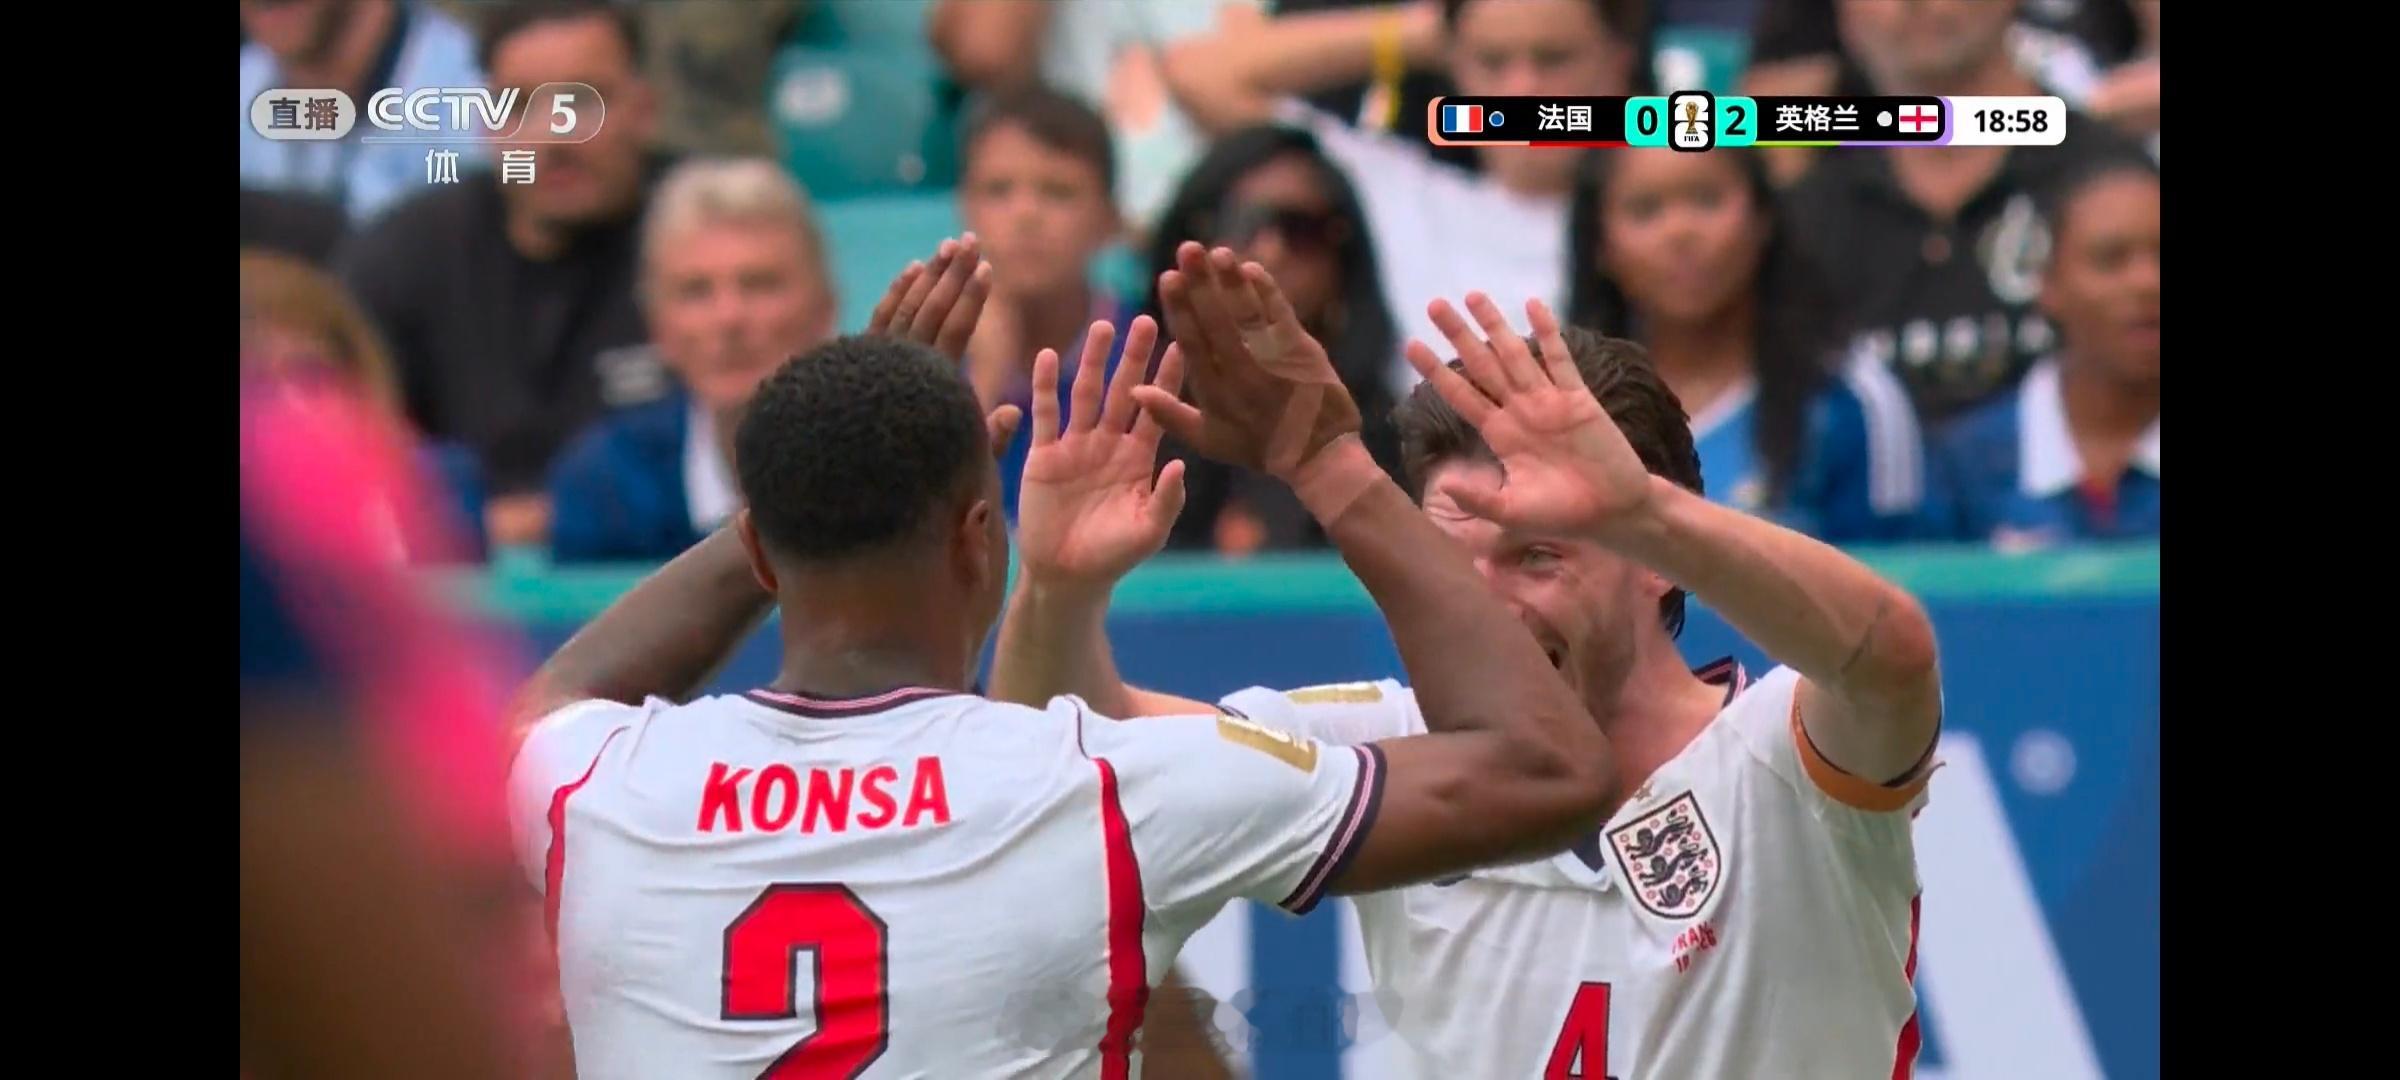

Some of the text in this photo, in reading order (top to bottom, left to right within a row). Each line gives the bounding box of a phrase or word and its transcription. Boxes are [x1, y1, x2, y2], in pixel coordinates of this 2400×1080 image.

[697, 756, 951, 834] KONSA
[720, 881, 889, 1080] 2
[1544, 981, 1619, 1080] 4
